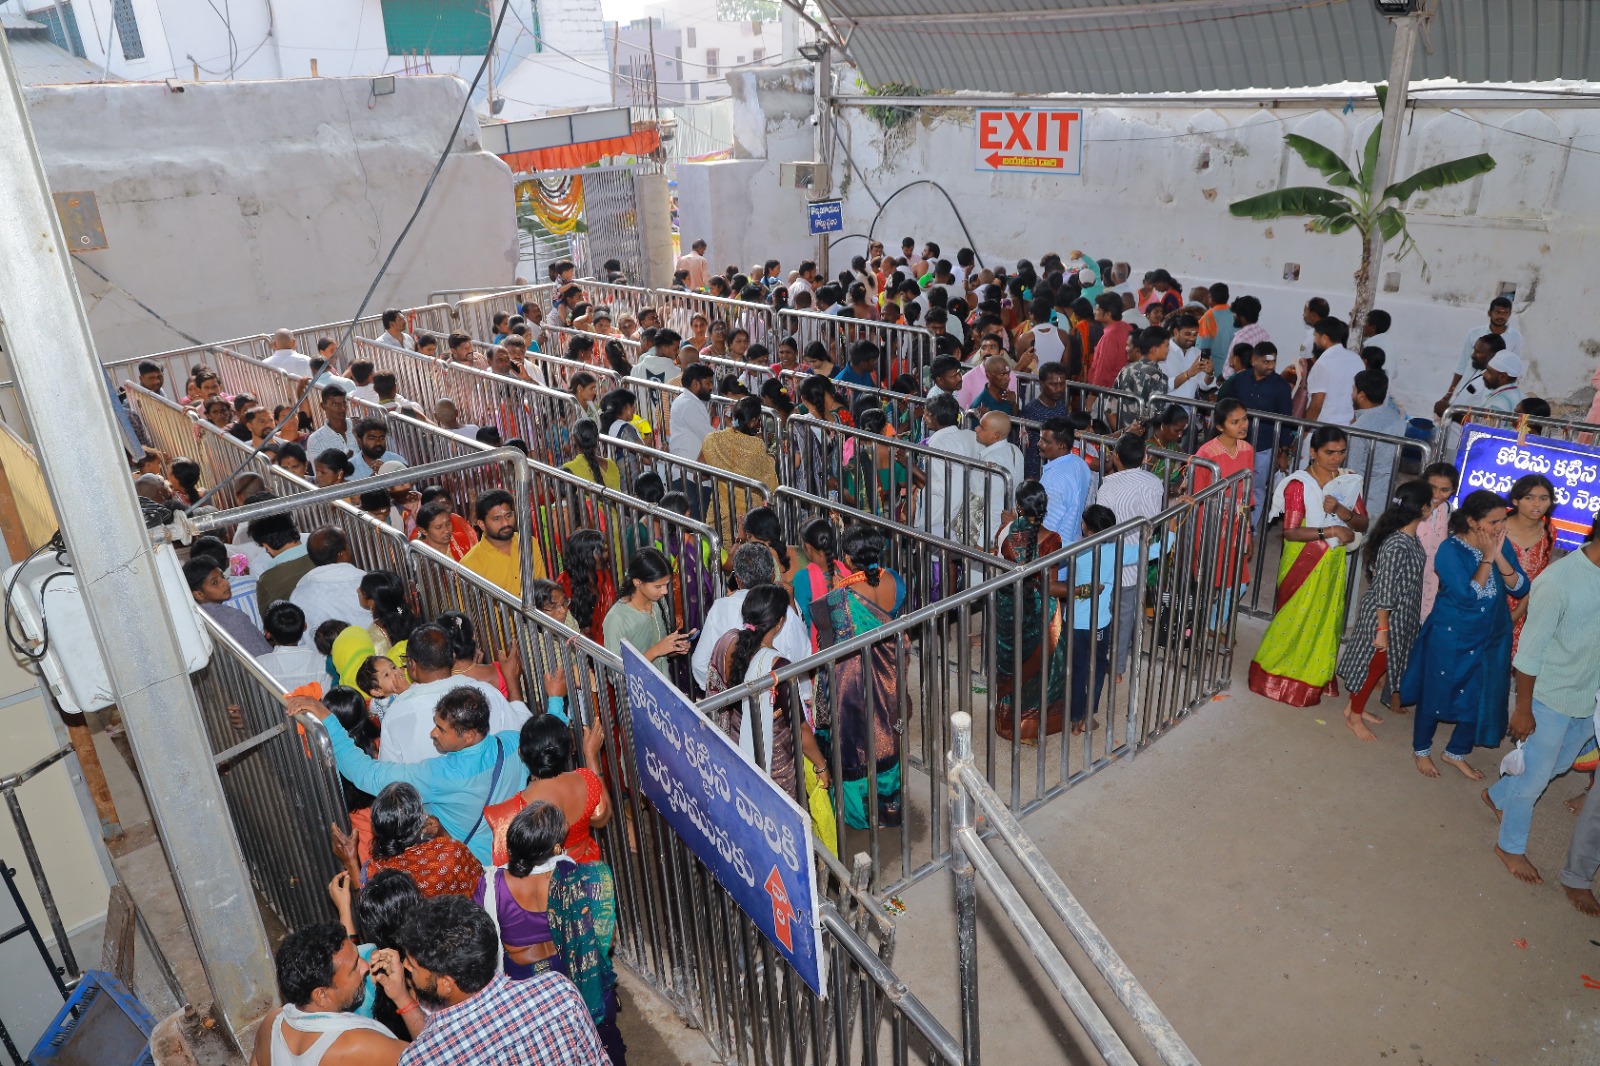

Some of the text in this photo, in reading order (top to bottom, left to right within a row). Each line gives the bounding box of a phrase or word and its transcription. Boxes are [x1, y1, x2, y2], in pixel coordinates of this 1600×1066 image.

[980, 112, 1078, 151] EXIT
[1496, 446, 1597, 486] కోడెను కట్టిన
[630, 673, 799, 872] కోడెను కట్టిన వారికి
[645, 747, 755, 887] దర్శనమునకు
